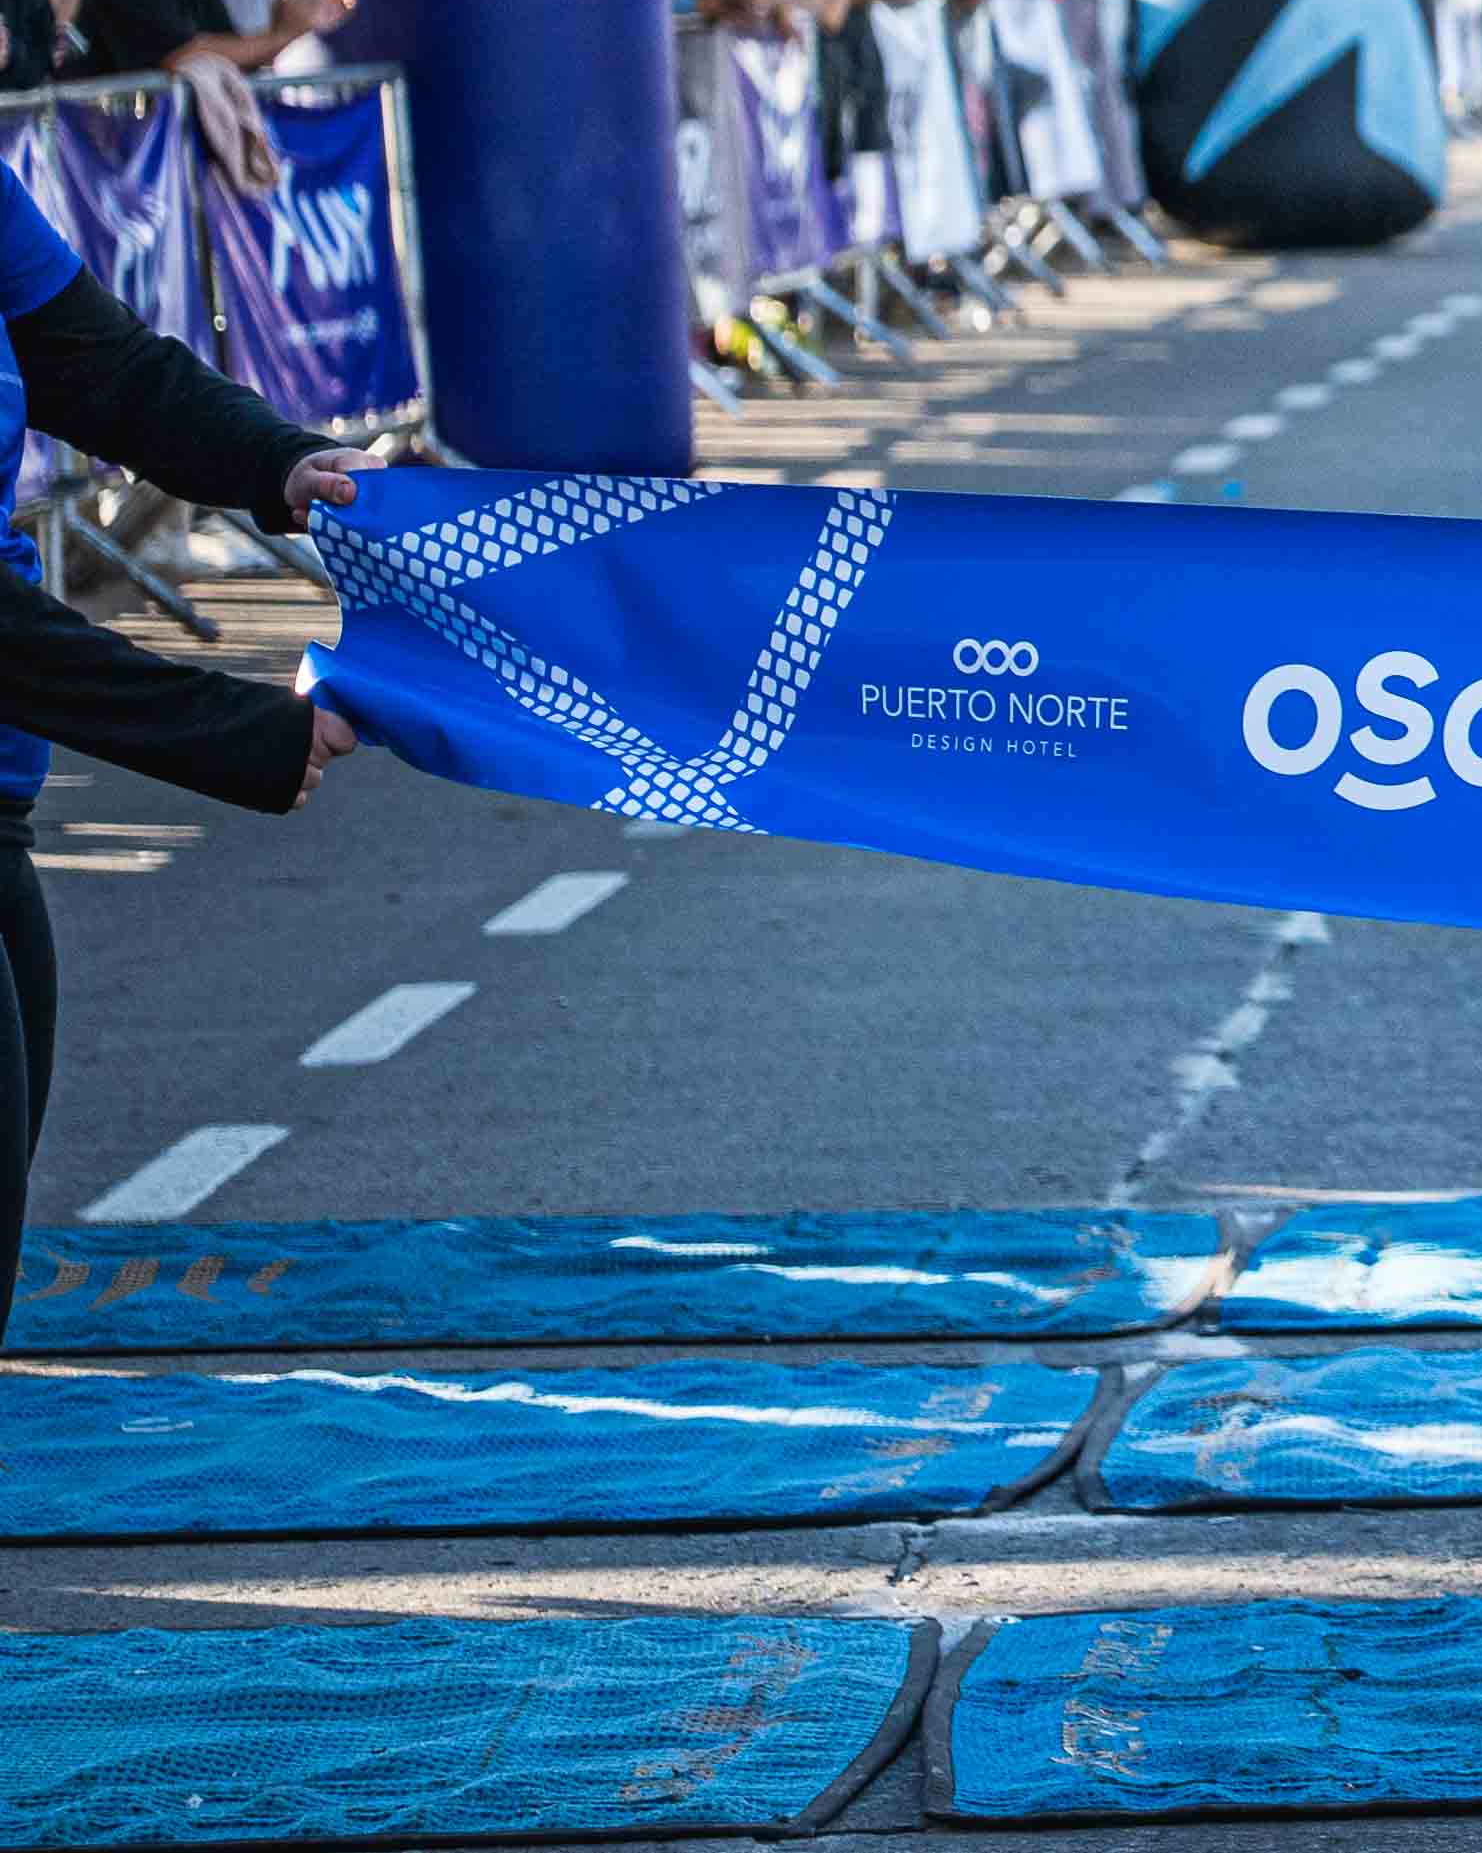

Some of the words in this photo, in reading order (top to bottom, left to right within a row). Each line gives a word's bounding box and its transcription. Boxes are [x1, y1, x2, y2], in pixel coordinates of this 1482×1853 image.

[861, 684, 997, 726] PUERTO
[1008, 692, 1129, 733] NORTE
[911, 733, 995, 754] DESIGN
[1005, 738, 1078, 759] HOTEL
